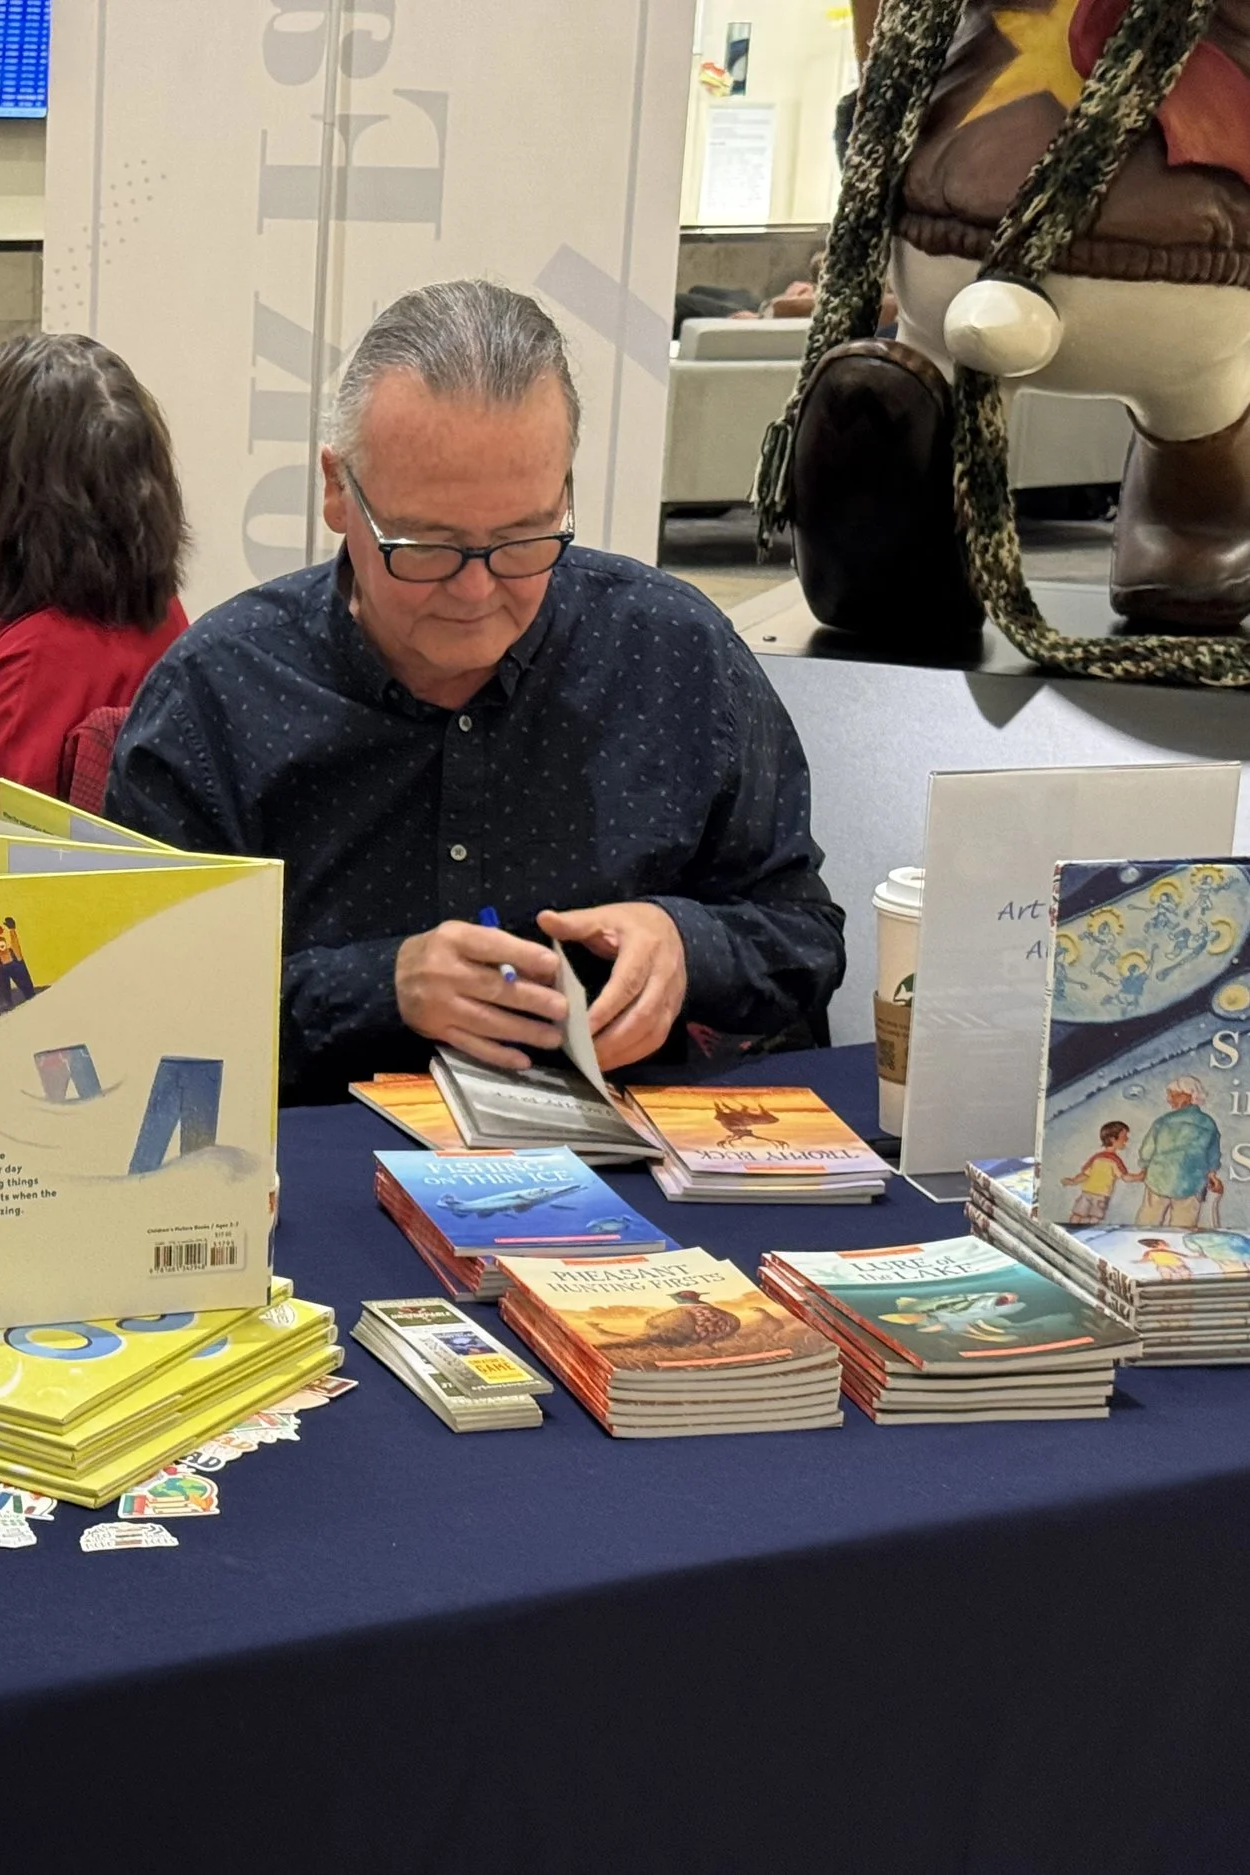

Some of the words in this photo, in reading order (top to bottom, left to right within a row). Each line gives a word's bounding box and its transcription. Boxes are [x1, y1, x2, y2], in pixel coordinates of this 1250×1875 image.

[997, 900, 1047, 921] Art
[694, 1150, 757, 1161] BUCK
[767, 1150, 860, 1160] TROPHY
[4, 1164, 23, 1175] day
[424, 1159, 546, 1175] FISHING
[7, 1177, 39, 1188] things
[452, 1172, 524, 1186] THIN
[526, 1170, 576, 1184] ICE
[12, 1192, 38, 1201] when
[40, 1189, 57, 1198] the
[850, 1256, 928, 1273] LURE
[935, 1255, 954, 1265] of
[858, 1271, 892, 1282] the
[893, 1262, 980, 1281] LAKE
[550, 1264, 690, 1284] PHEASANT
[546, 1280, 647, 1293] HUNTING
[649, 1272, 727, 1290] FIRSTS
[475, 1362, 517, 1374] GAME
